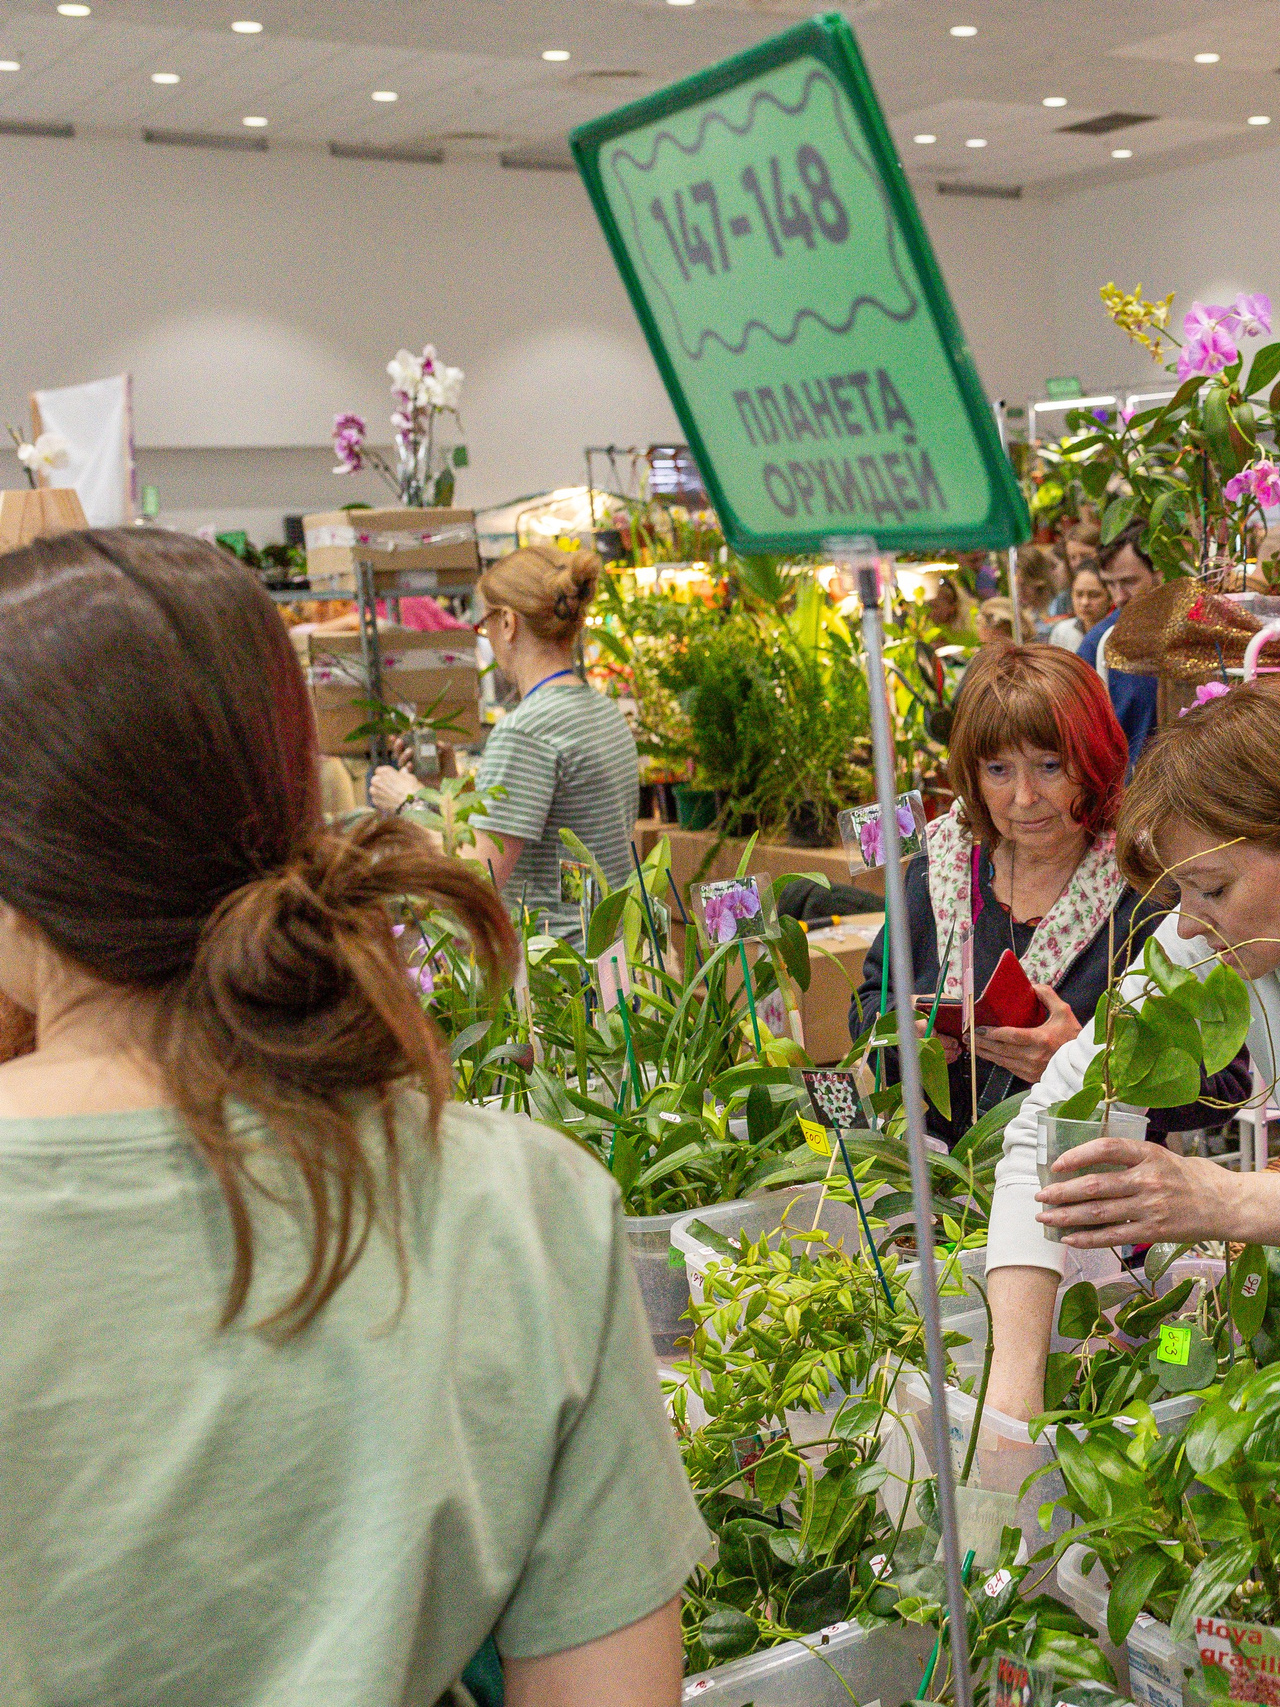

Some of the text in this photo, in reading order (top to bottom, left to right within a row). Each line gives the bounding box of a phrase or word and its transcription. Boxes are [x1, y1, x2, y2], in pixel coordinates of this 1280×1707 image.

[649, 143, 851, 282] 147-148
[731, 368, 916, 446] ПЛАНЕТА
[761, 433, 949, 524] ОРХИДЕЙ
[1196, 1617, 1263, 1647] Hoya
